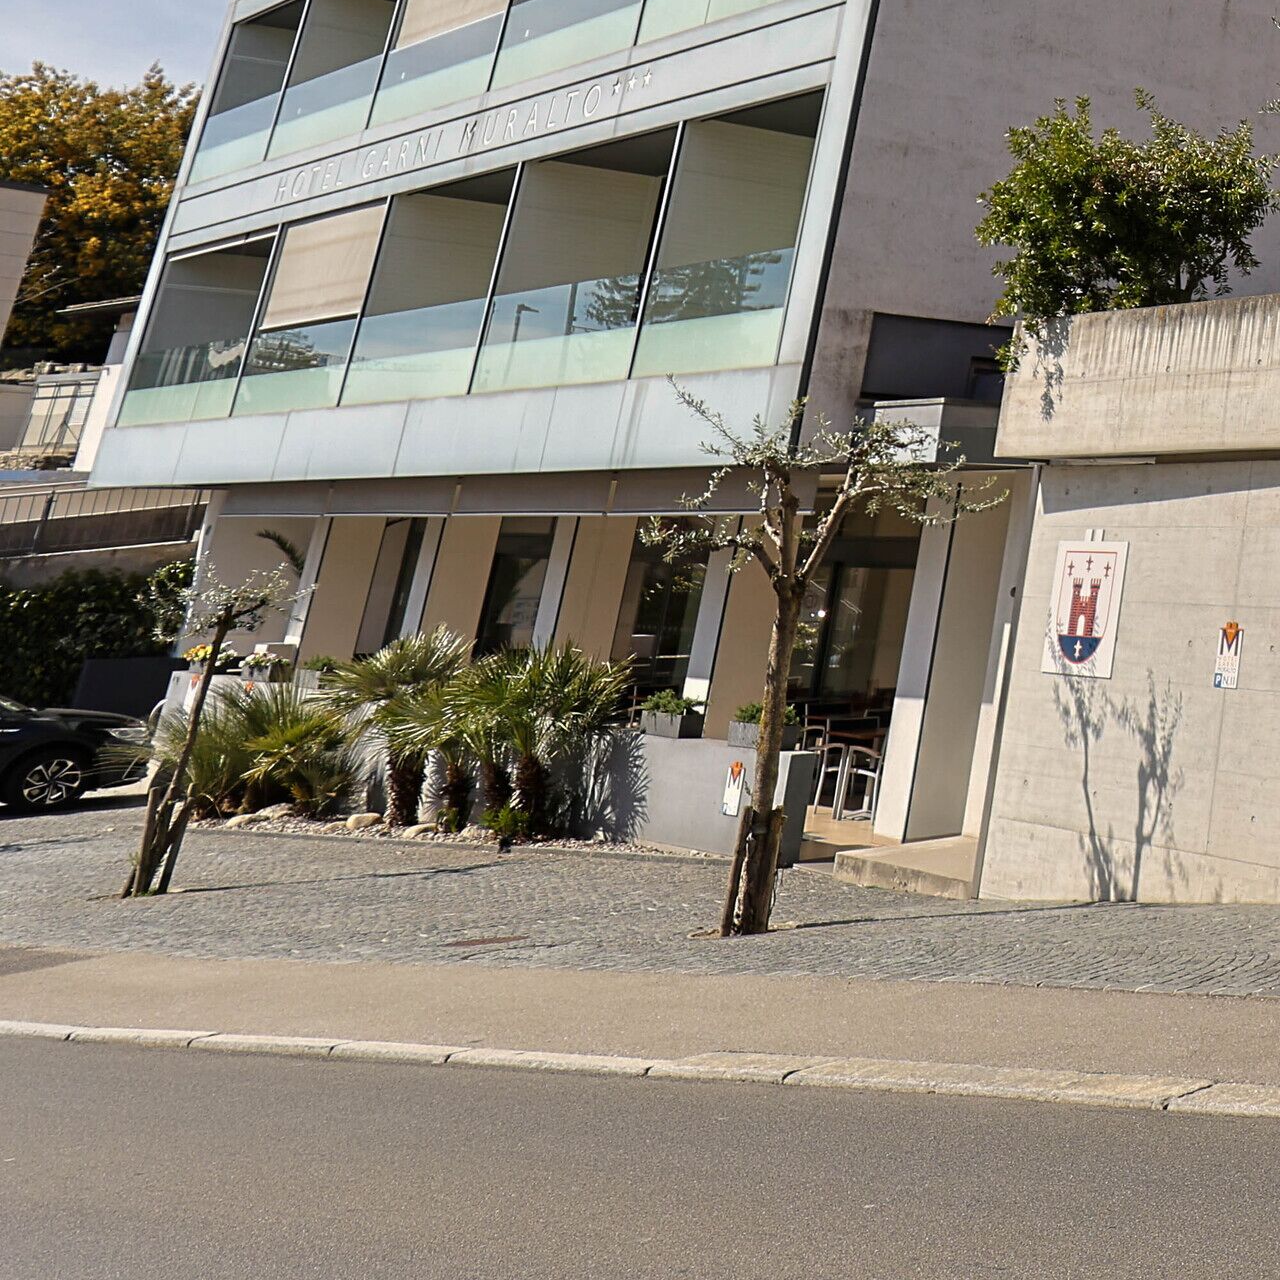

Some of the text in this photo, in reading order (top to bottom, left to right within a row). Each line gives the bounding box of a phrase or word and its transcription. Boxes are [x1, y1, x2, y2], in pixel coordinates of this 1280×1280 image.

[274, 83, 602, 203] HOTEL GARNI MURALTO
